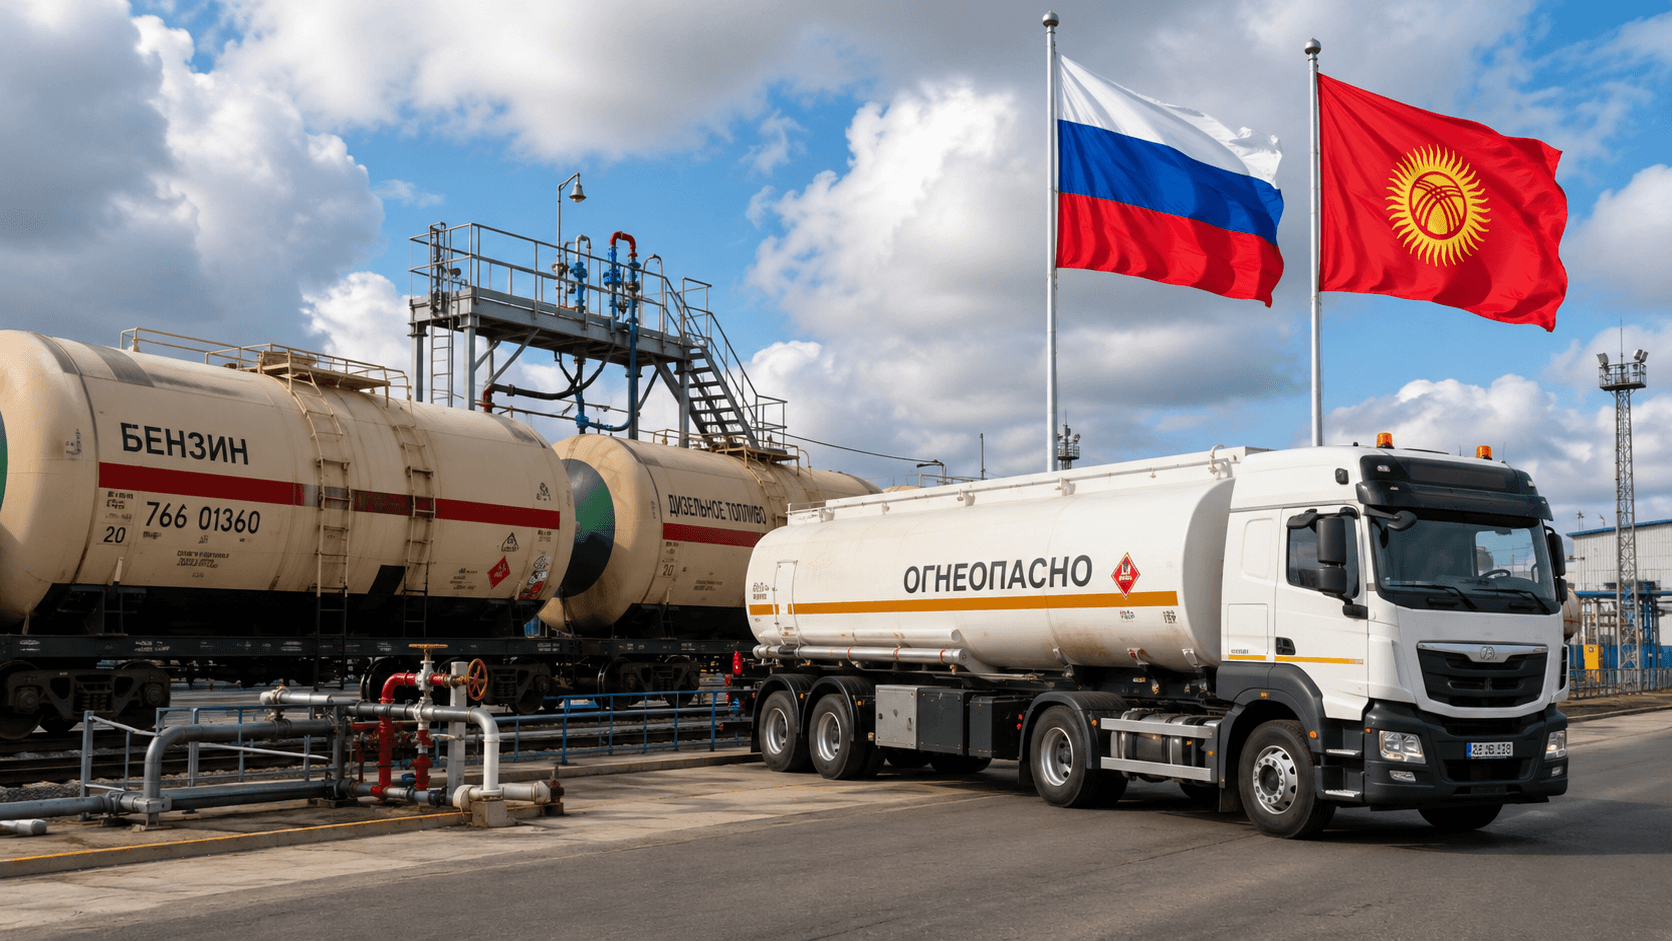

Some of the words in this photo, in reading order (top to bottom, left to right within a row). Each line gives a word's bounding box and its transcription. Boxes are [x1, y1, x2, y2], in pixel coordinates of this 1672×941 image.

[120, 422, 249, 465] БЕНЗИН
[145, 501, 188, 529] 766
[199, 506, 260, 534] 01360
[668, 494, 726, 520] ДИЗЕЛЬНОЕ
[725, 502, 767, 525] ТОПЛИВО
[103, 526, 126, 543] 20
[662, 564, 675, 577] 20
[904, 555, 1092, 593] ОГНЕОПАСНО
